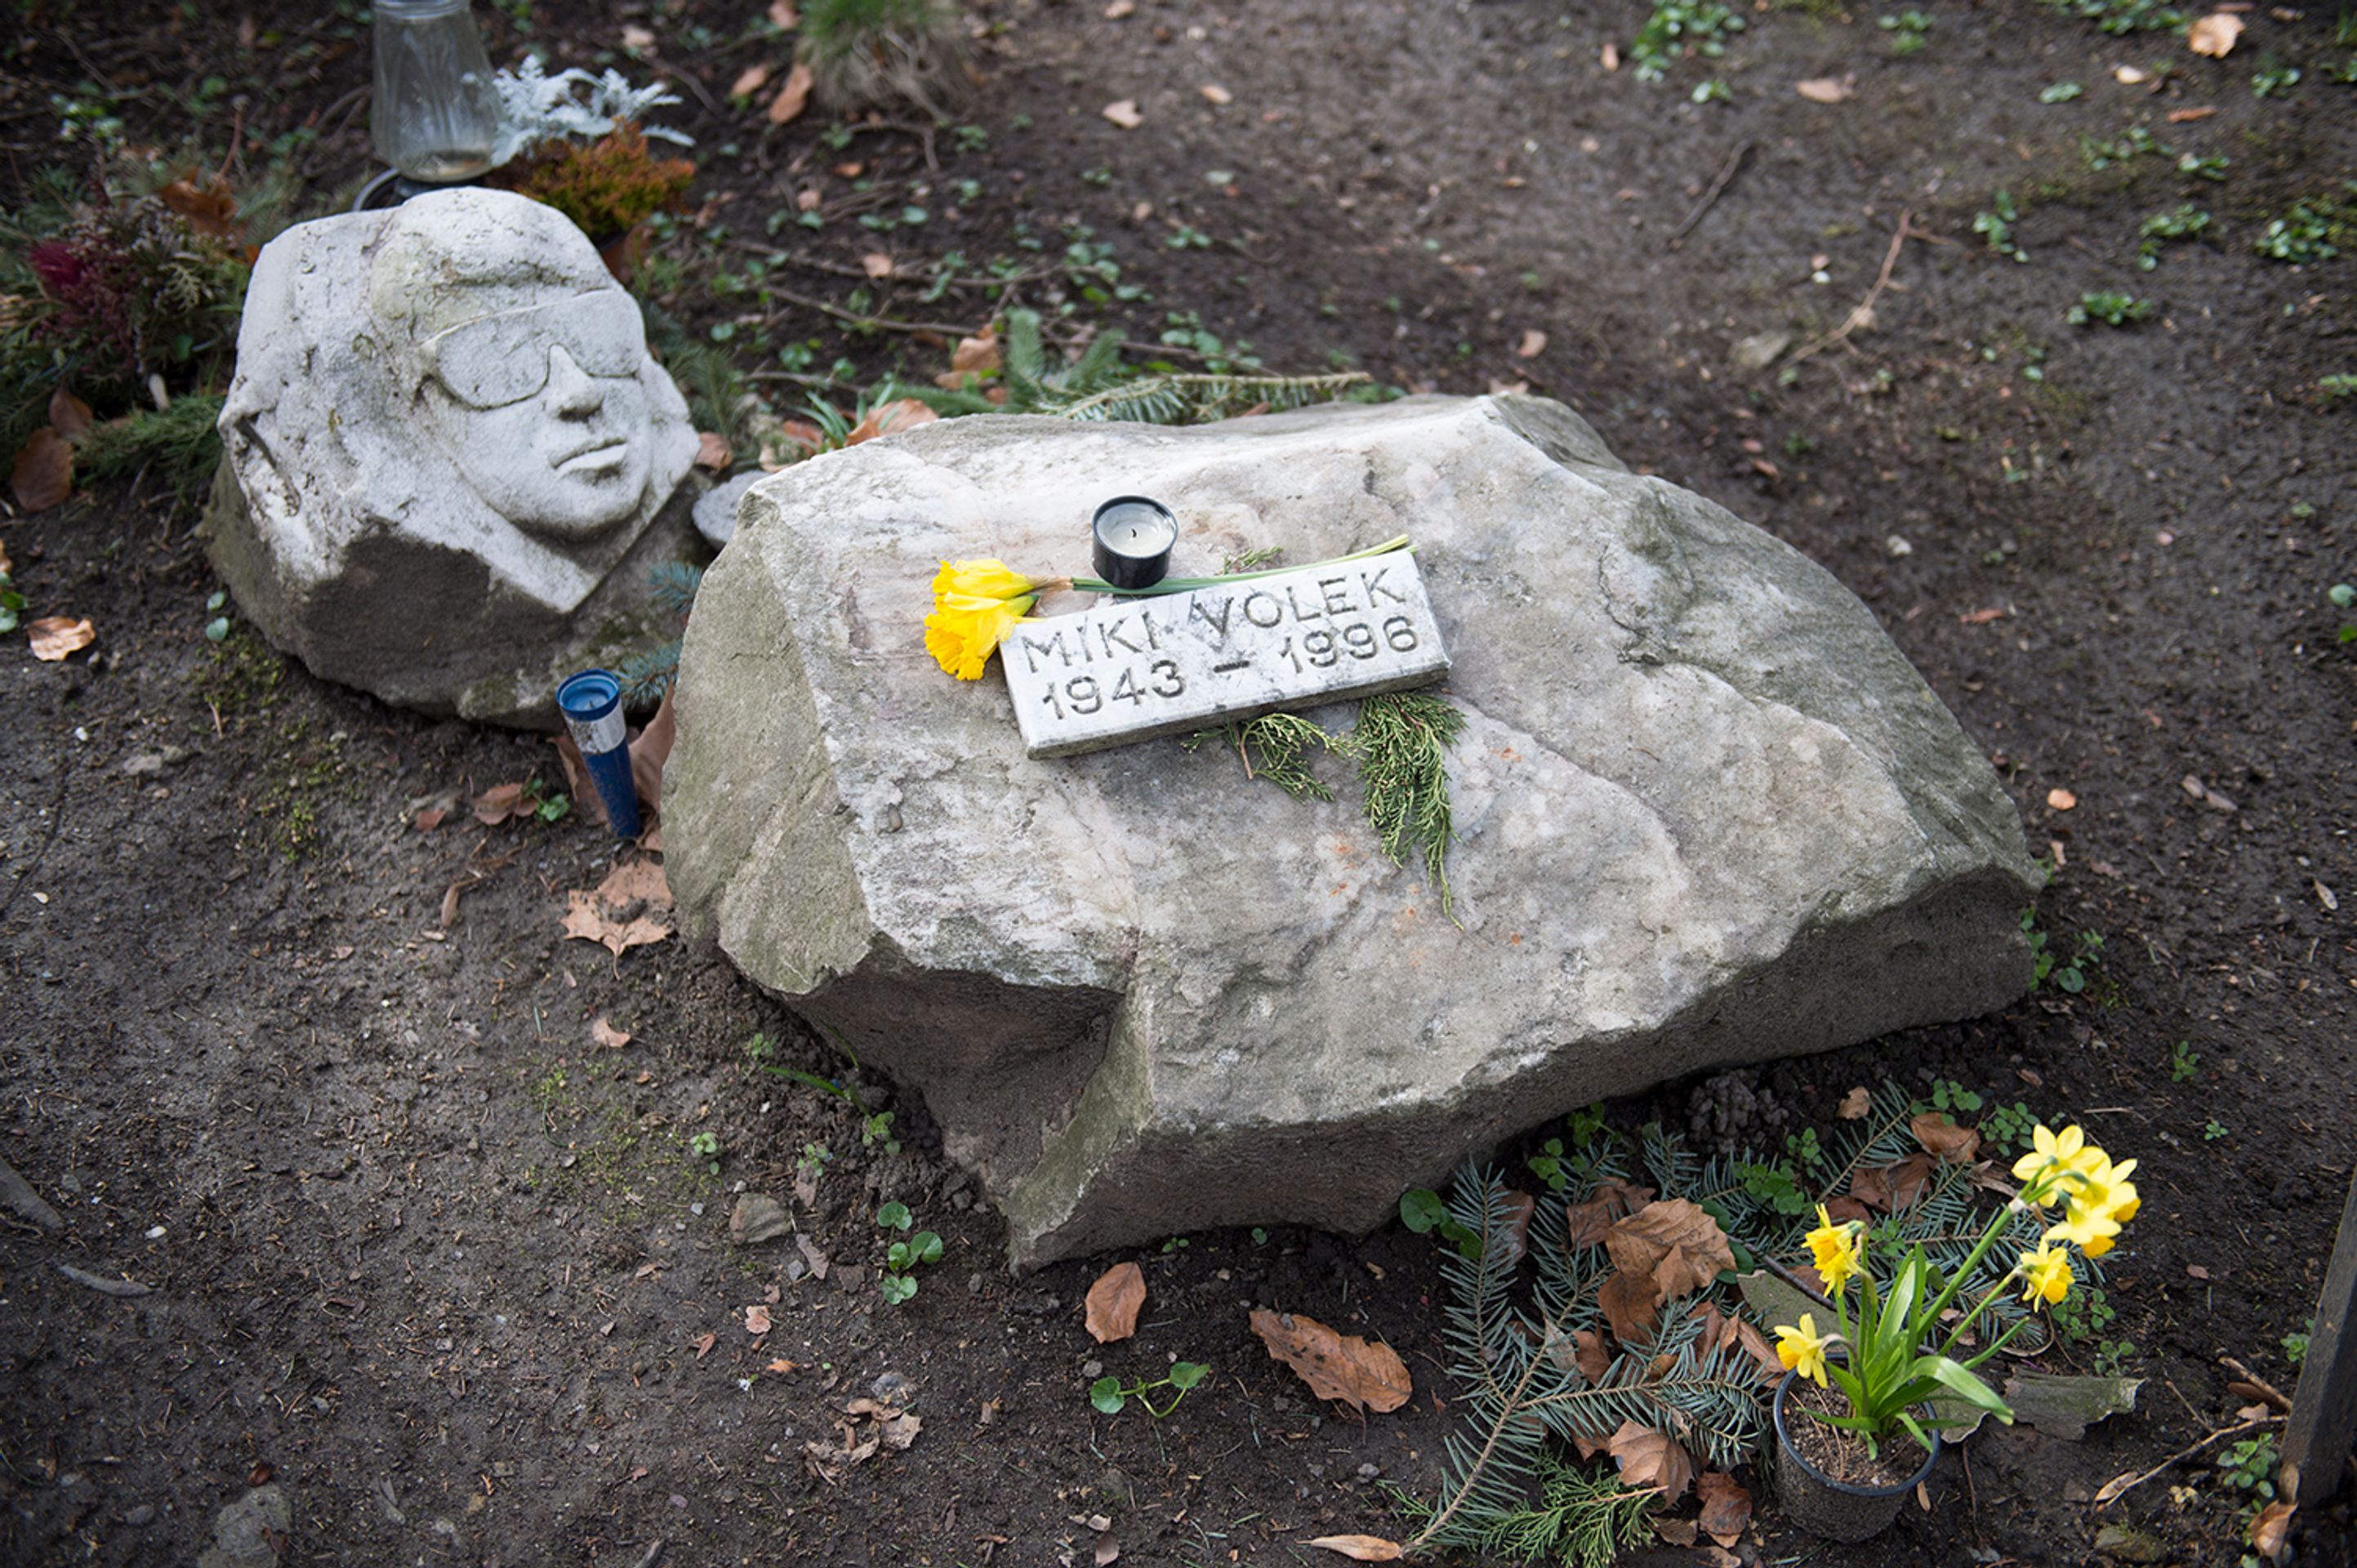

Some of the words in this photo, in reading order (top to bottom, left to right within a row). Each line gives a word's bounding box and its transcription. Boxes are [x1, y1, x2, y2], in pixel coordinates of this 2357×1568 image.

[1020, 611, 1160, 673] MIKI
[1192, 567, 1406, 637] VOLEK
[1043, 659, 1187, 720] 1943
[1280, 616, 1419, 675] 1996
